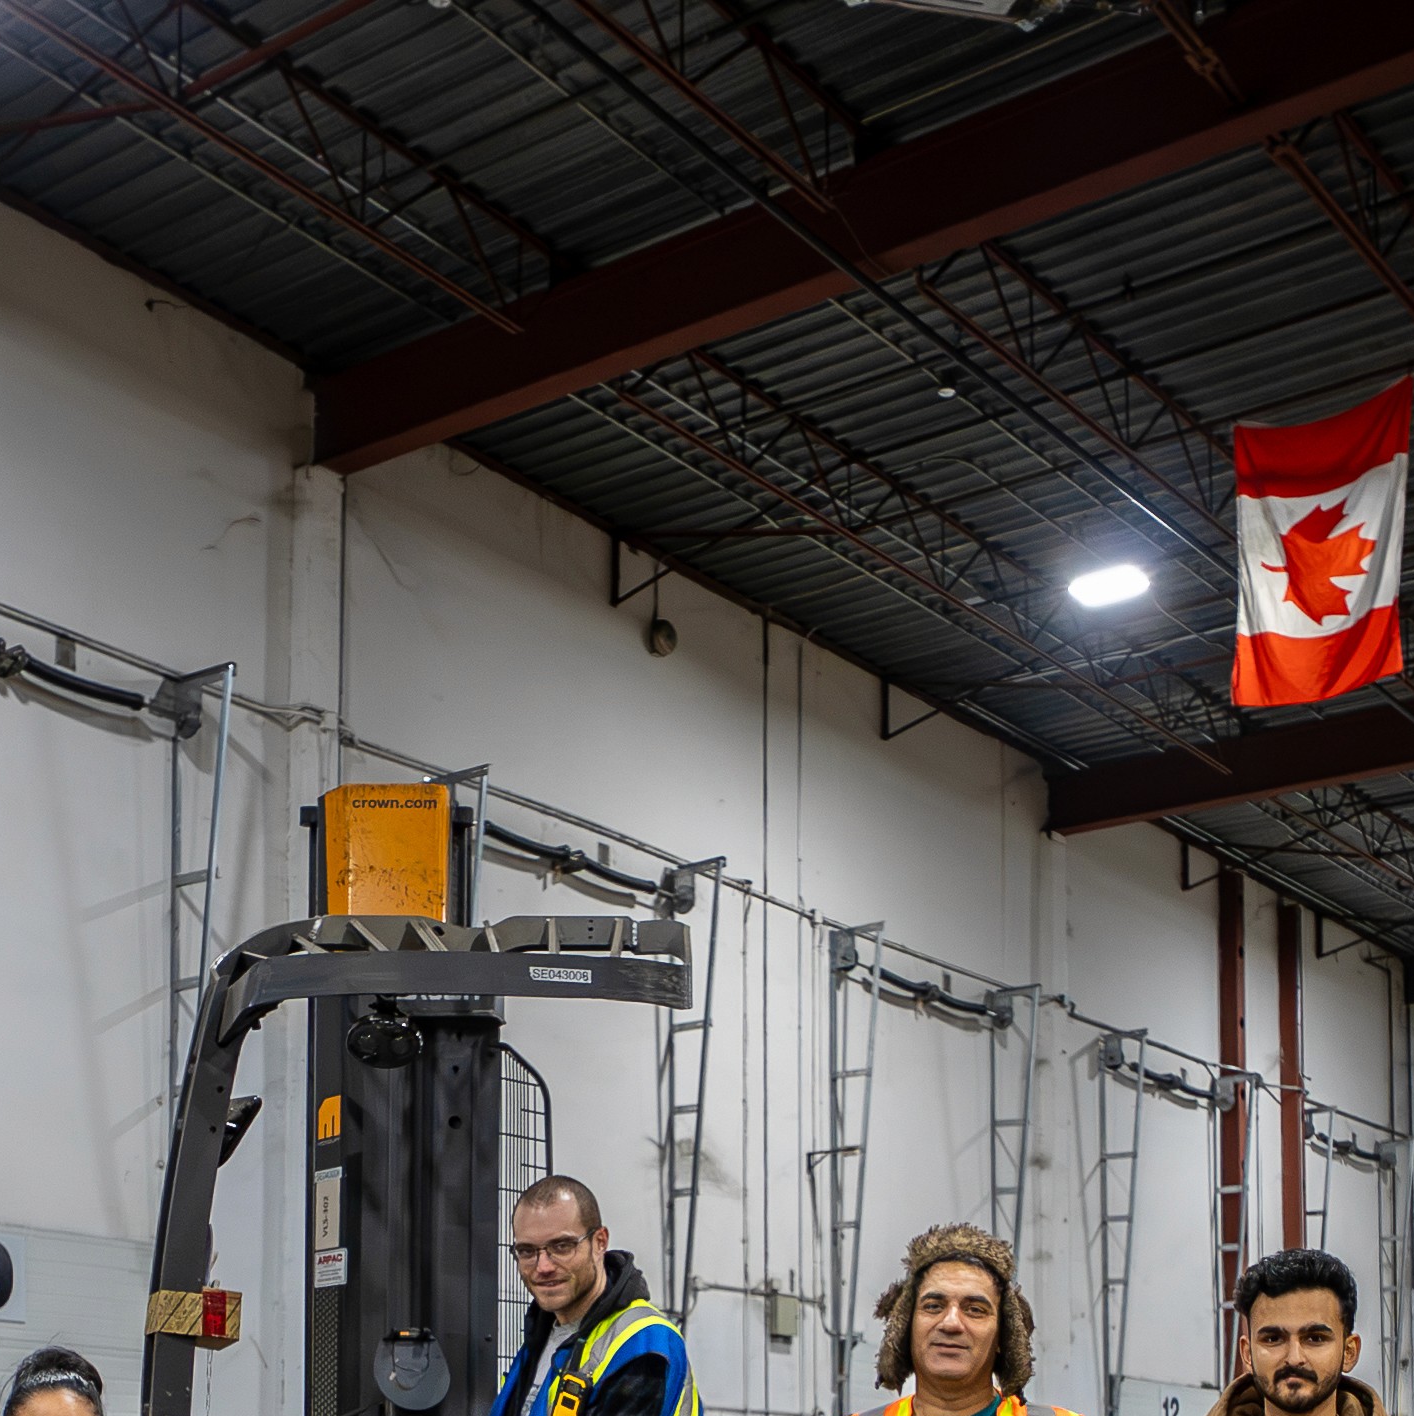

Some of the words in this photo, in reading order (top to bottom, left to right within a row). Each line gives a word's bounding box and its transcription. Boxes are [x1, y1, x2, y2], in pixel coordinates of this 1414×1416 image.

[352, 798, 437, 809] crown.com
[532, 968, 589, 982] SE043008
[317, 1253, 343, 1265] ARPAC
